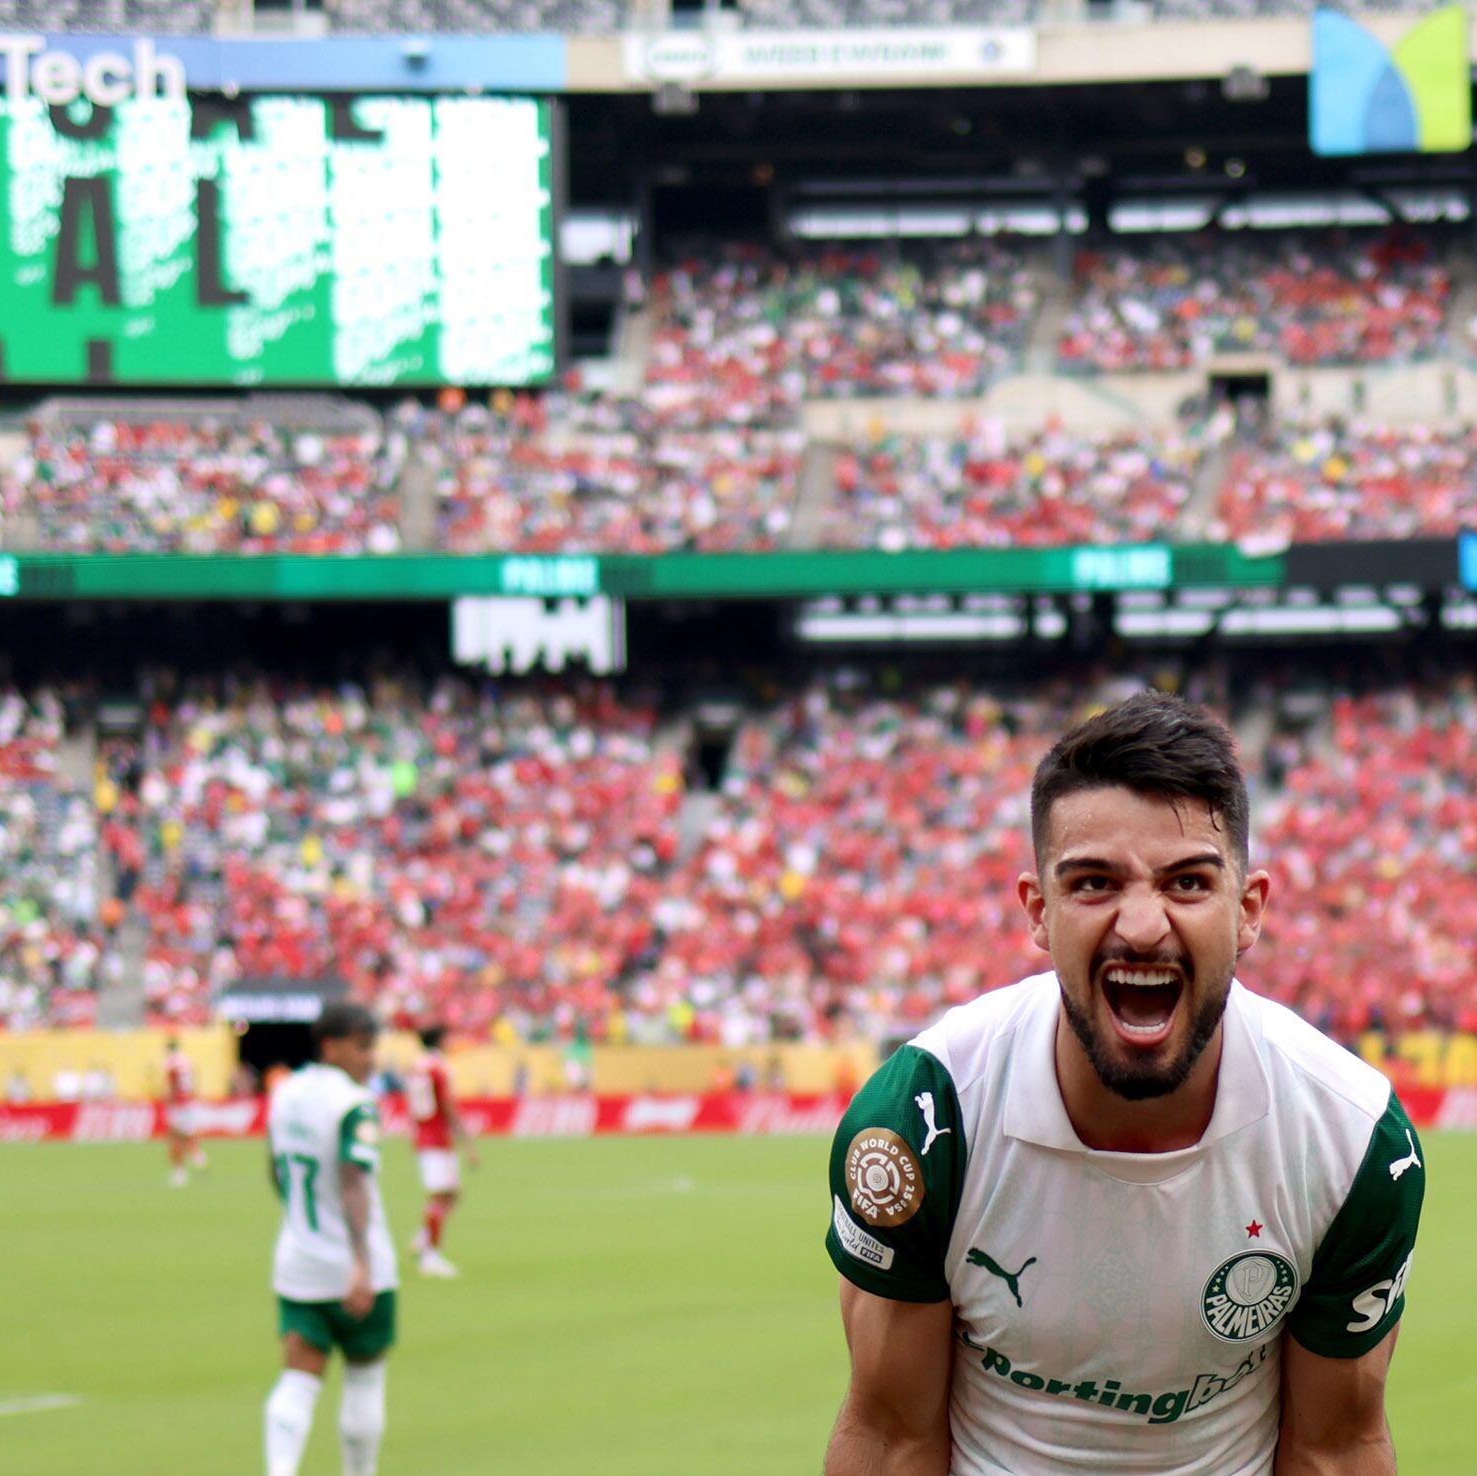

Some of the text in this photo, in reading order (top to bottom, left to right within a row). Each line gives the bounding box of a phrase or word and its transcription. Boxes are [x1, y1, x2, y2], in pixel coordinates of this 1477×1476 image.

[859, 1137, 899, 1156] WORLD
[899, 1155, 916, 1181] CUP
[852, 1187, 879, 1219] FIFA
[1205, 1285, 1293, 1338] PALMEIRAS
